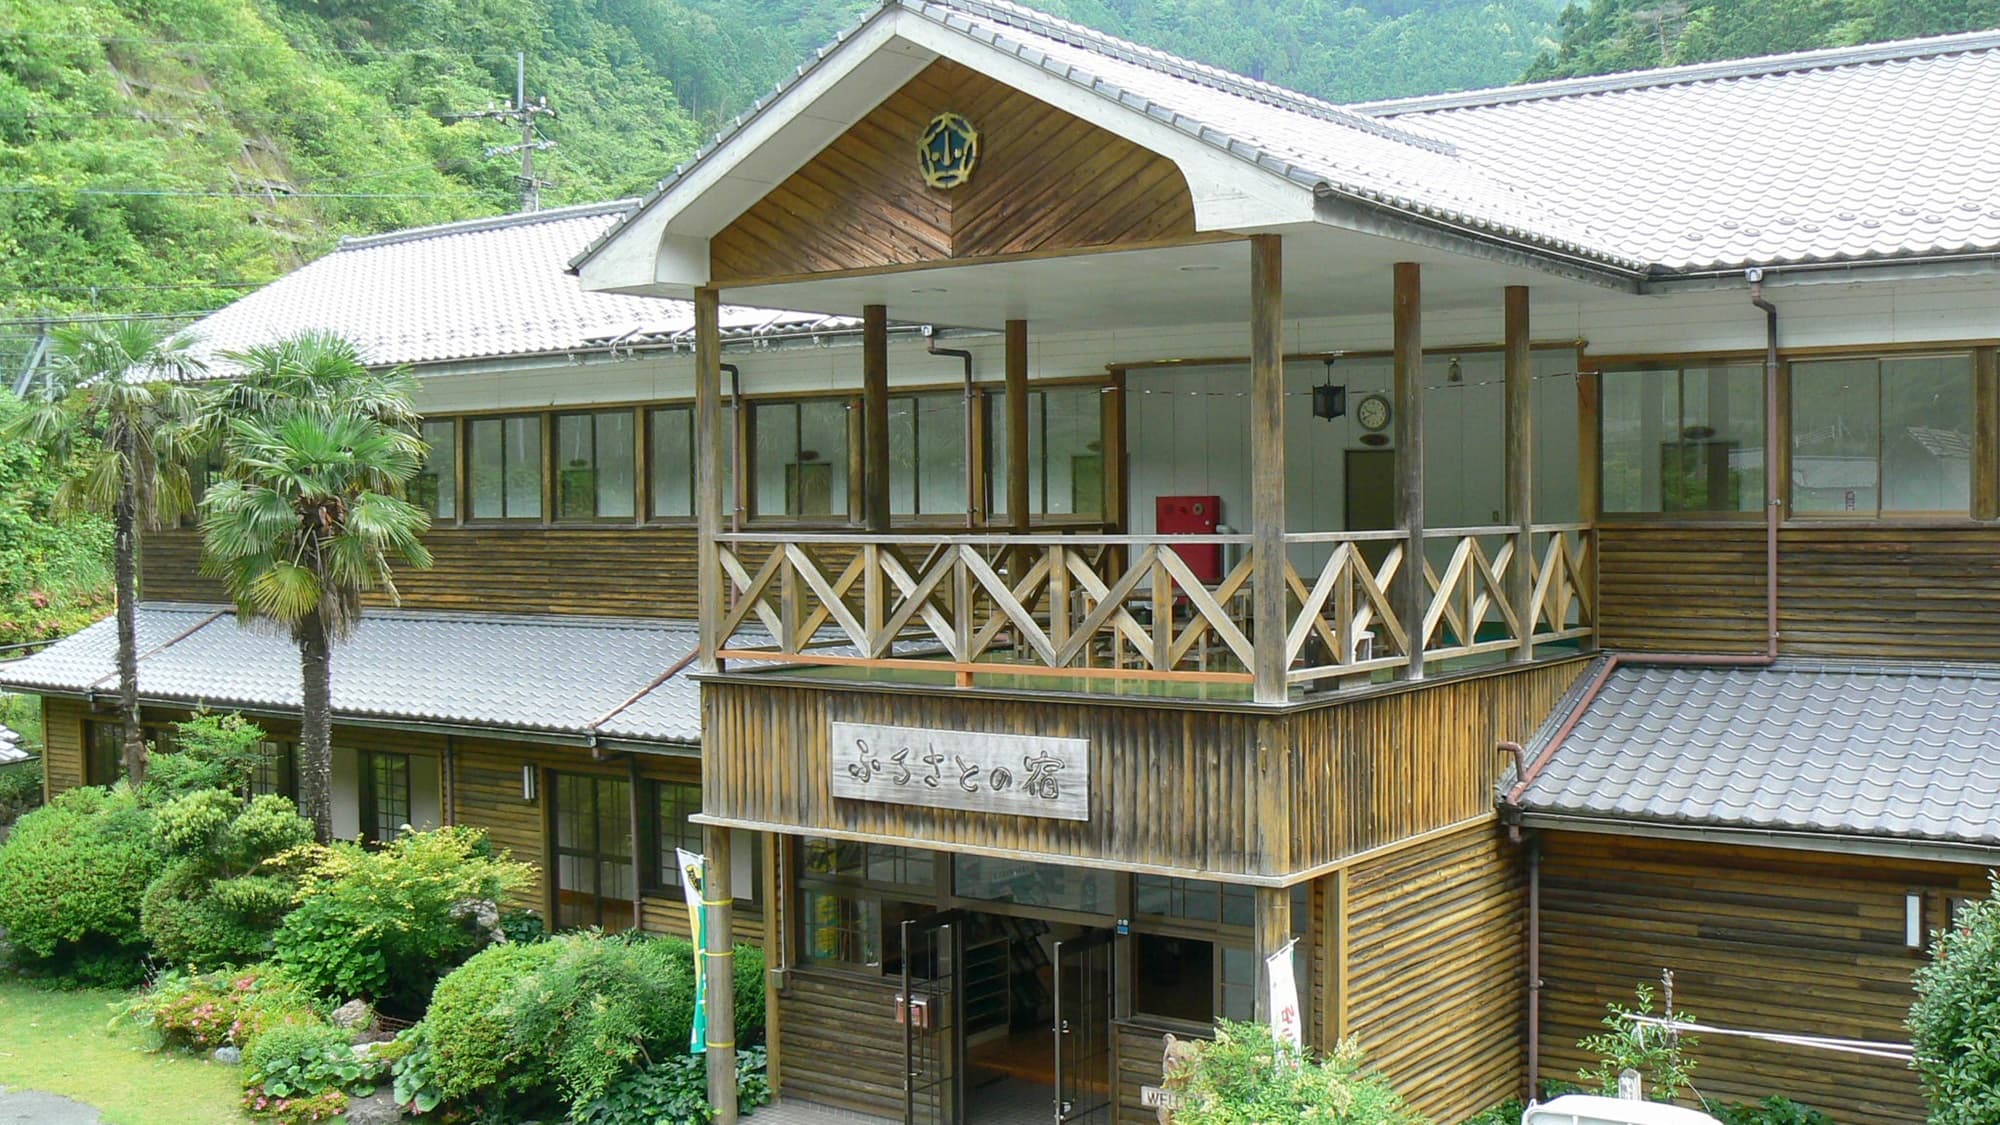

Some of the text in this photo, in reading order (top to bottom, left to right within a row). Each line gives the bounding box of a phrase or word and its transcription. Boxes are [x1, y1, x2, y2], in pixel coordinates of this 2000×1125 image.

[848, 738, 1065, 799] ふるさとの宿
